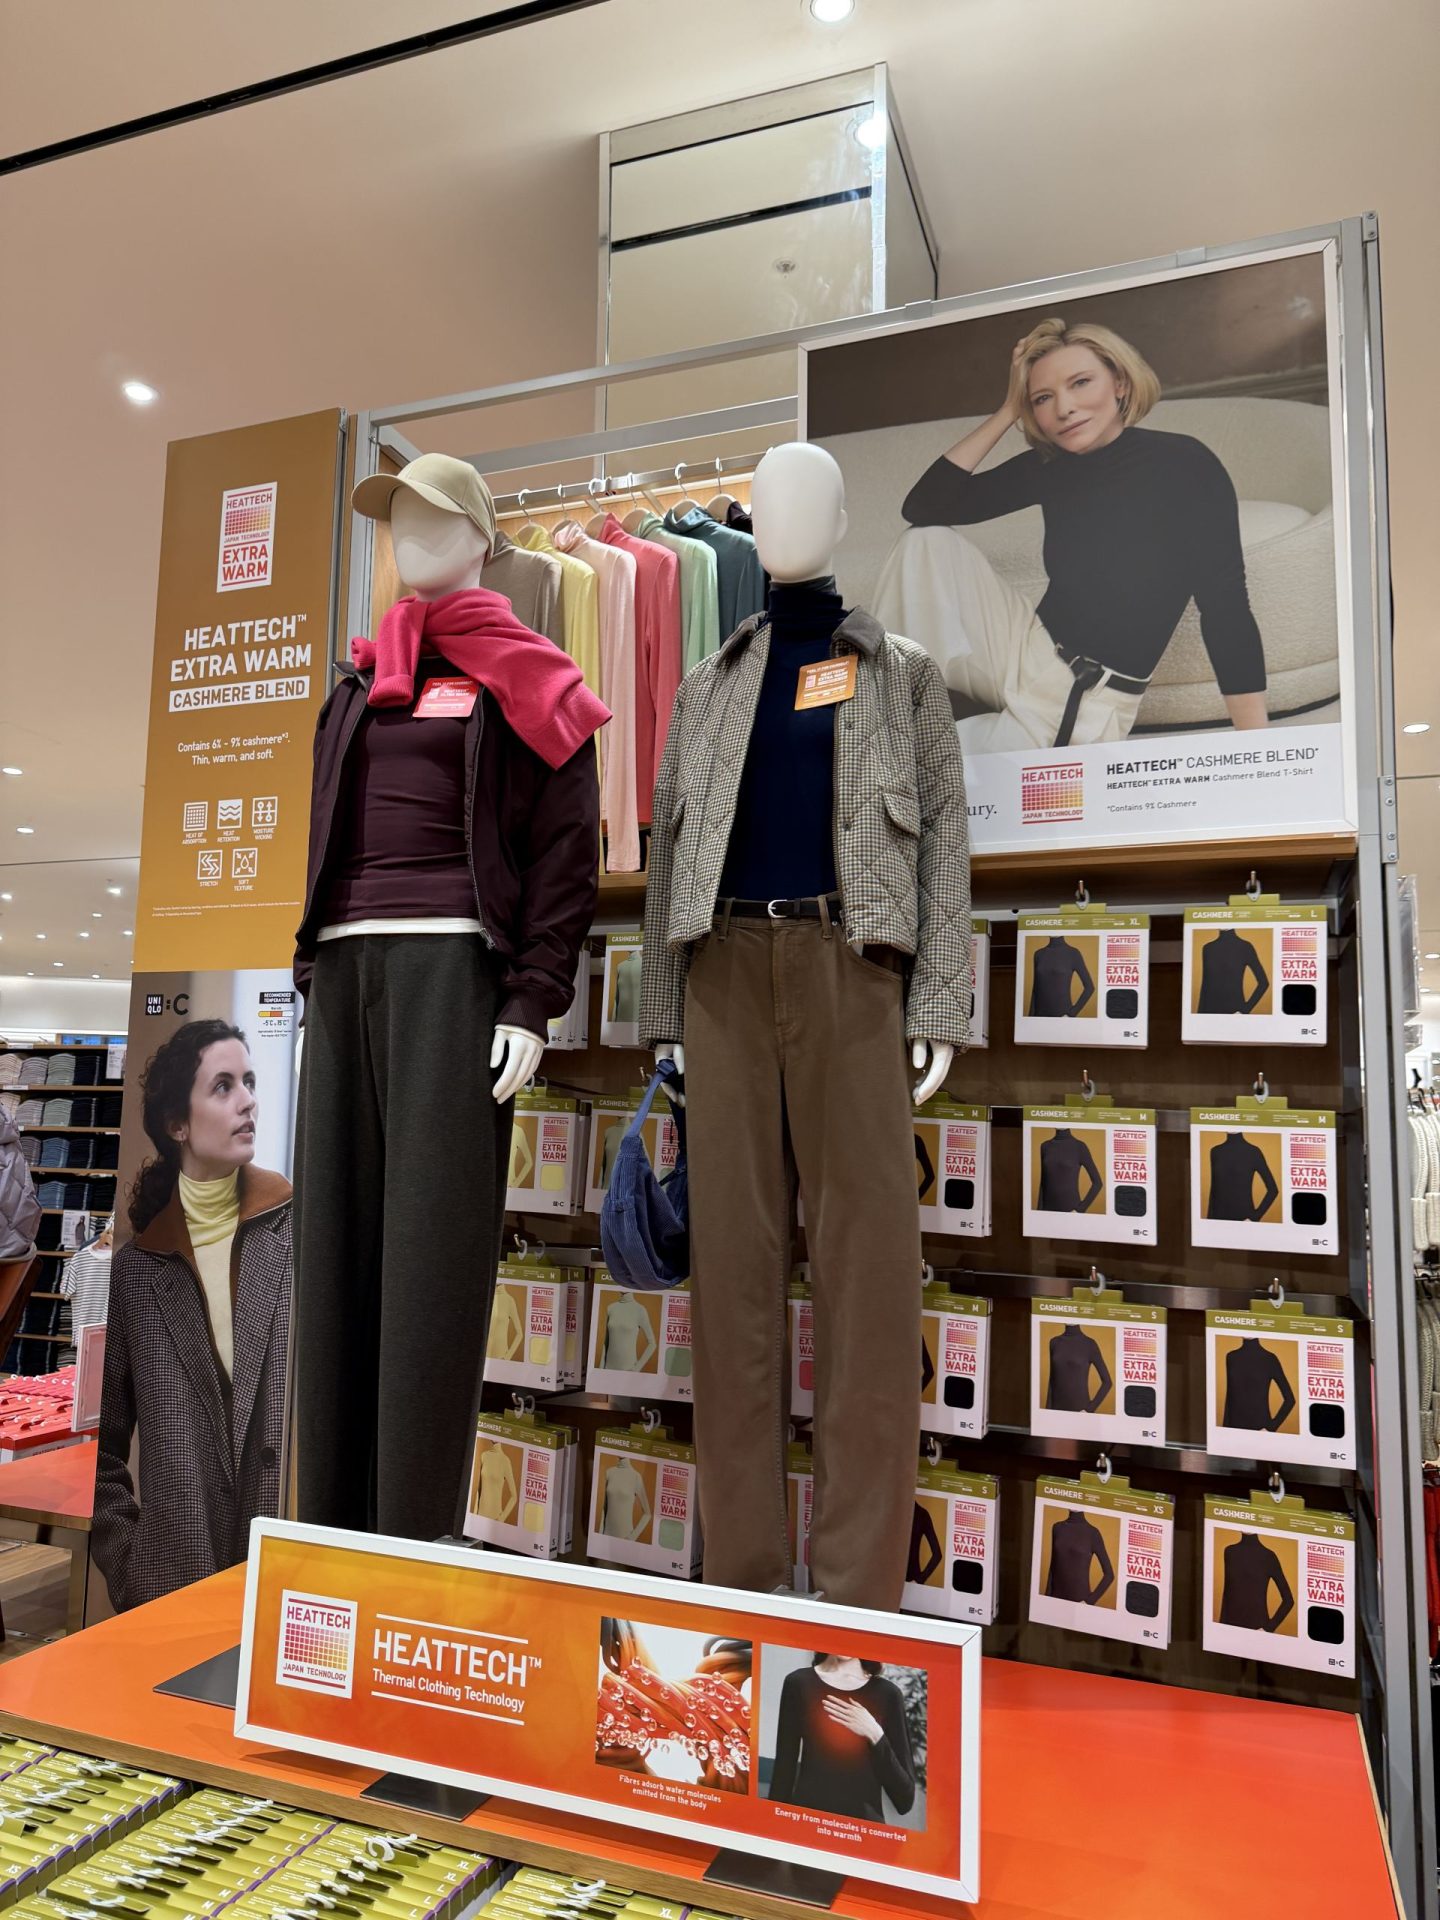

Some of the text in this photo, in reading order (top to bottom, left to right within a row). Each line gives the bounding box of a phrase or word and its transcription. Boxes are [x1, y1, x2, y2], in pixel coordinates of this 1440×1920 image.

[226, 493, 273, 509] HEATTECH
[241, 531, 270, 540] TECHNOLOGY
[223, 544, 268, 564] EXTRA
[222, 560, 268, 581] WARM
[171, 644, 311, 682] EXTRA WARM
[173, 680, 305, 708] CASHMERE BLEND
[178, 740, 210, 752] Contains
[212, 739, 221, 749] 6%
[231, 737, 240, 747] 9%
[192, 749, 274, 765] Thin, warm, and soft.
[1186, 751, 1262, 769] CASHMERE
[1021, 767, 1084, 783] HEATTECH
[1153, 777, 1181, 786] EXTRA
[1184, 775, 1210, 784] WARM
[1212, 772, 1255, 782] Cashmere
[1257, 769, 1280, 779] Blend
[1283, 767, 1314, 777] T-Shirt
[1157, 800, 1197, 809] Cashmere
[967, 803, 998, 819] ury.
[1022, 809, 1083, 820] JAPAN TECHNOLOGY
[1192, 911, 1233, 919] CASHMERE
[1129, 918, 1140, 926] XL
[1106, 966, 1139, 974] EXTRA
[1281, 960, 1316, 969] EXTRA
[1106, 975, 1139, 983] WARM
[1282, 970, 1317, 978] WARM
[542, 1152, 566, 1160] WARM
[946, 1156, 975, 1165] EXTRA
[946, 1165, 975, 1175] WARM
[1114, 1162, 1146, 1171] EXTRA
[1291, 1167, 1326, 1177] EXTRA
[1114, 1171, 1146, 1180] WARM
[1291, 1177, 1327, 1187] WARM
[972, 1304, 978, 1312] M
[1040, 1303, 1078, 1313] CASHMERE
[531, 1315, 552, 1324] EXTRA
[1215, 1316, 1343, 1333] CASHMERE S
[531, 1324, 552, 1333] WARM
[946, 1322, 978, 1330] HEATTECH
[1124, 1330, 1156, 1338] HEATTECH
[1307, 1345, 1344, 1353] HEATTECH
[946, 1351, 976, 1363] EXTRA
[946, 1360, 976, 1373] WARM
[1124, 1360, 1156, 1371] EXTRA
[1124, 1370, 1156, 1381] WARM
[1308, 1377, 1344, 1388] EXTRA
[1308, 1387, 1344, 1399] WARM
[525, 1479, 547, 1491] EXTRA
[982, 1486, 987, 1494] S
[525, 1487, 547, 1500] WARM
[661, 1496, 686, 1507] EXTRA
[1044, 1486, 1164, 1514] CASHMERE XS
[661, 1505, 686, 1517] WARM
[955, 1504, 987, 1513] HEATTECH
[1213, 1508, 1344, 1535] CASHMERE XS
[1129, 1522, 1163, 1534] HEATTECH
[954, 1534, 985, 1547] EXTRA
[953, 1544, 985, 1557] WARM
[1307, 1544, 1345, 1556] HEATTECH
[1127, 1554, 1161, 1569] EXTRA
[1127, 1565, 1161, 1579] WARM
[1307, 1578, 1344, 1593] EXTRA
[1307, 1589, 1345, 1604] WARM
[286, 1605, 351, 1630] HEATTECH
[283, 1662, 347, 1682] JAPAN TECHNOLOGY
[373, 1668, 525, 1713] Thermal Clothing Technology
[619, 1774, 721, 1803] Fibres adsorb water molecules
[632, 1787, 707, 1810] emitted from the body
[775, 1807, 907, 1842] Energy from molecules is converted
[816, 1826, 862, 1842] into warmth
[661, 1908, 673, 1920] XL
